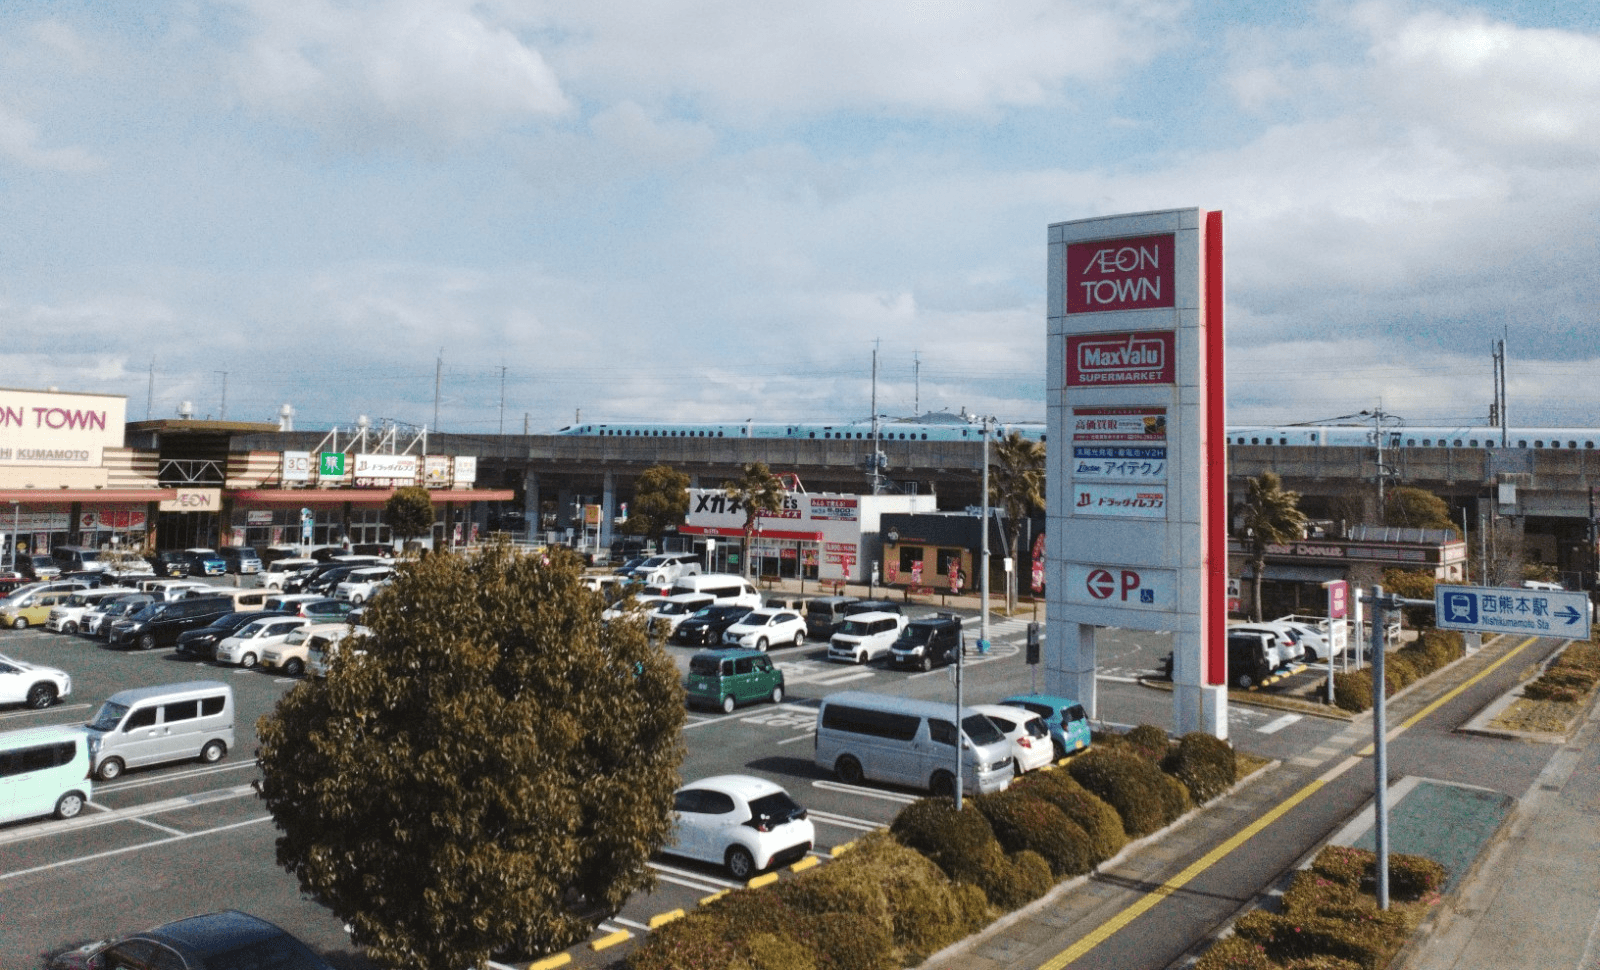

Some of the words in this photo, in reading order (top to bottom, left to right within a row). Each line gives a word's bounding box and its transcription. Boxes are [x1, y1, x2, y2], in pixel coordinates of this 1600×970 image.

[1080, 276, 1161, 305] TOWN
[1084, 335, 1158, 366] MaxValu
[1078, 371, 1164, 382] SUPERMARKET
[32, 407, 107, 431] TOWN
[1075, 418, 1118, 430] 高価買取
[16, 447, 89, 460] KUMAMOTO
[1104, 461, 1164, 476] アイテクノ
[1098, 496, 1164, 508] ドラッグイレブン
[1120, 569, 1140, 602] P
[1481, 594, 1549, 617] 西熊本駅
[1481, 616, 1535, 629] Nishikumamoto
